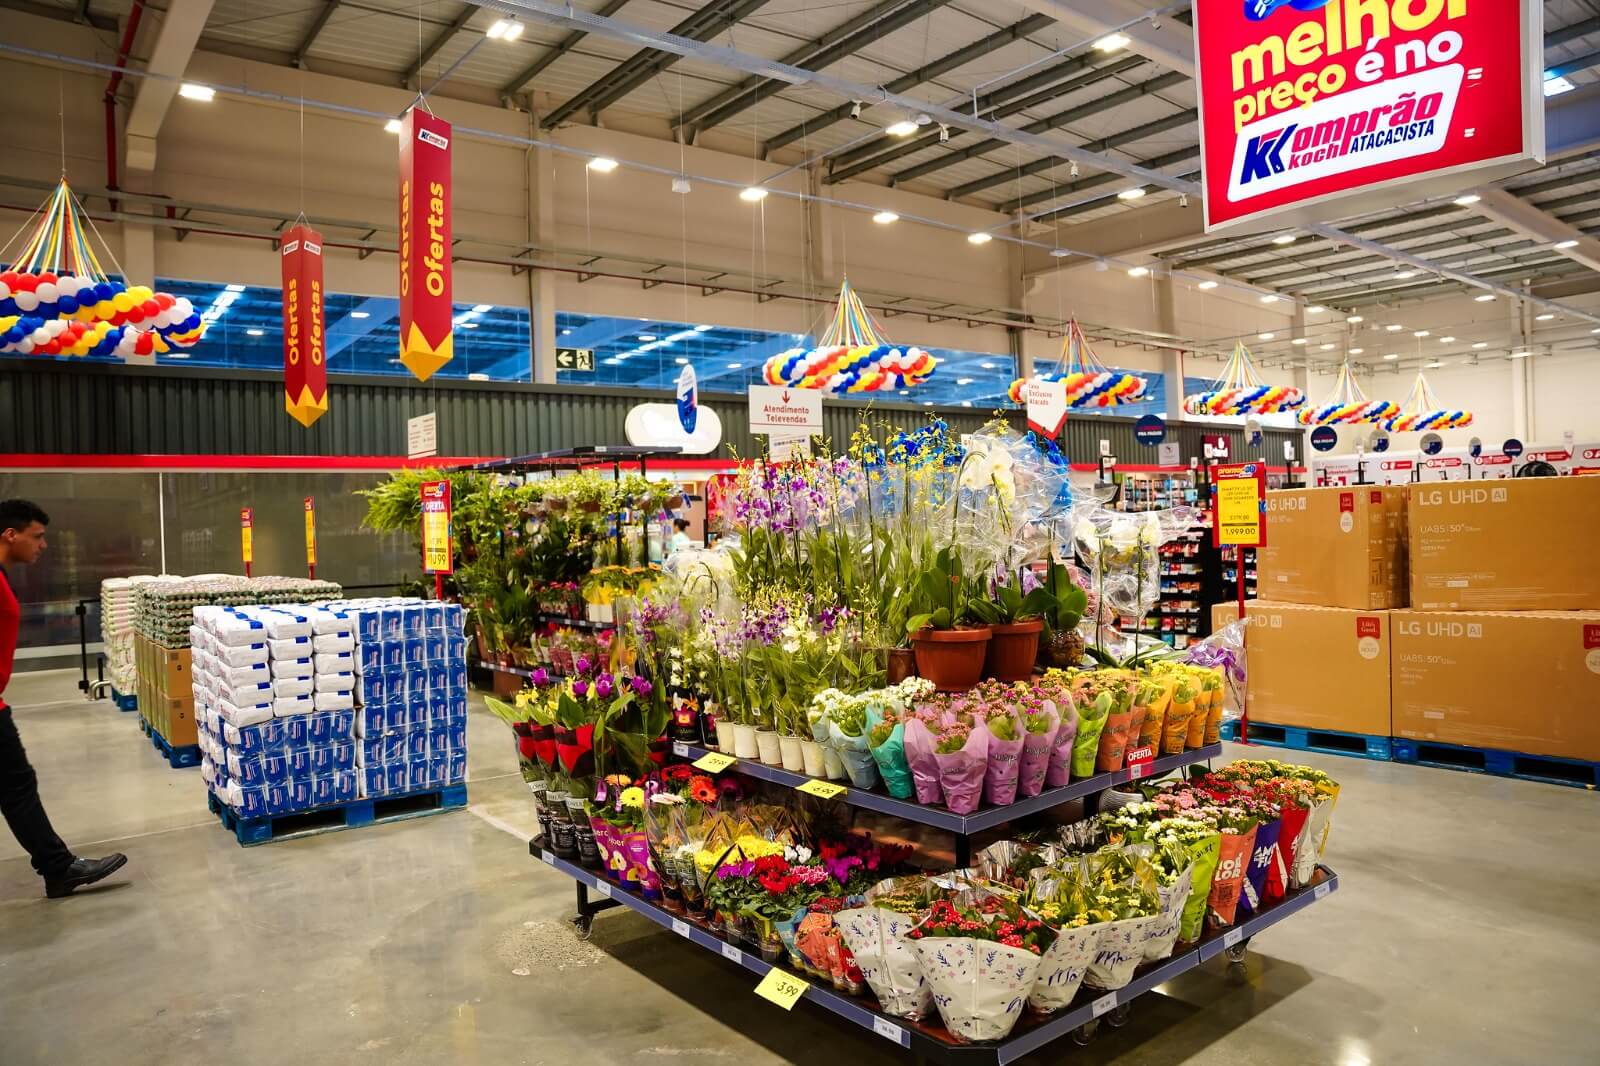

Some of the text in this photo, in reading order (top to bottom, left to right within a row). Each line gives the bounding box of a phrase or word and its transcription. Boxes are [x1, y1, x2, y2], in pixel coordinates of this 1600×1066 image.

[1234, 30, 1463, 133] preço é no
[1351, 119, 1435, 153] ATACADISTA
[424, 182, 444, 296] Ofertas
[288, 278, 299, 365] Ofertas
[311, 280, 322, 365] Ofertas
[763, 404, 810, 414] Atendimento
[766, 414, 807, 423] Televendas
[1280, 497, 1297, 510] UHD
[1419, 488, 1506, 505] LG UHD AI
[1400, 621, 1480, 637] LG UHD AI
[1128, 748, 1152, 761] OFERTA
